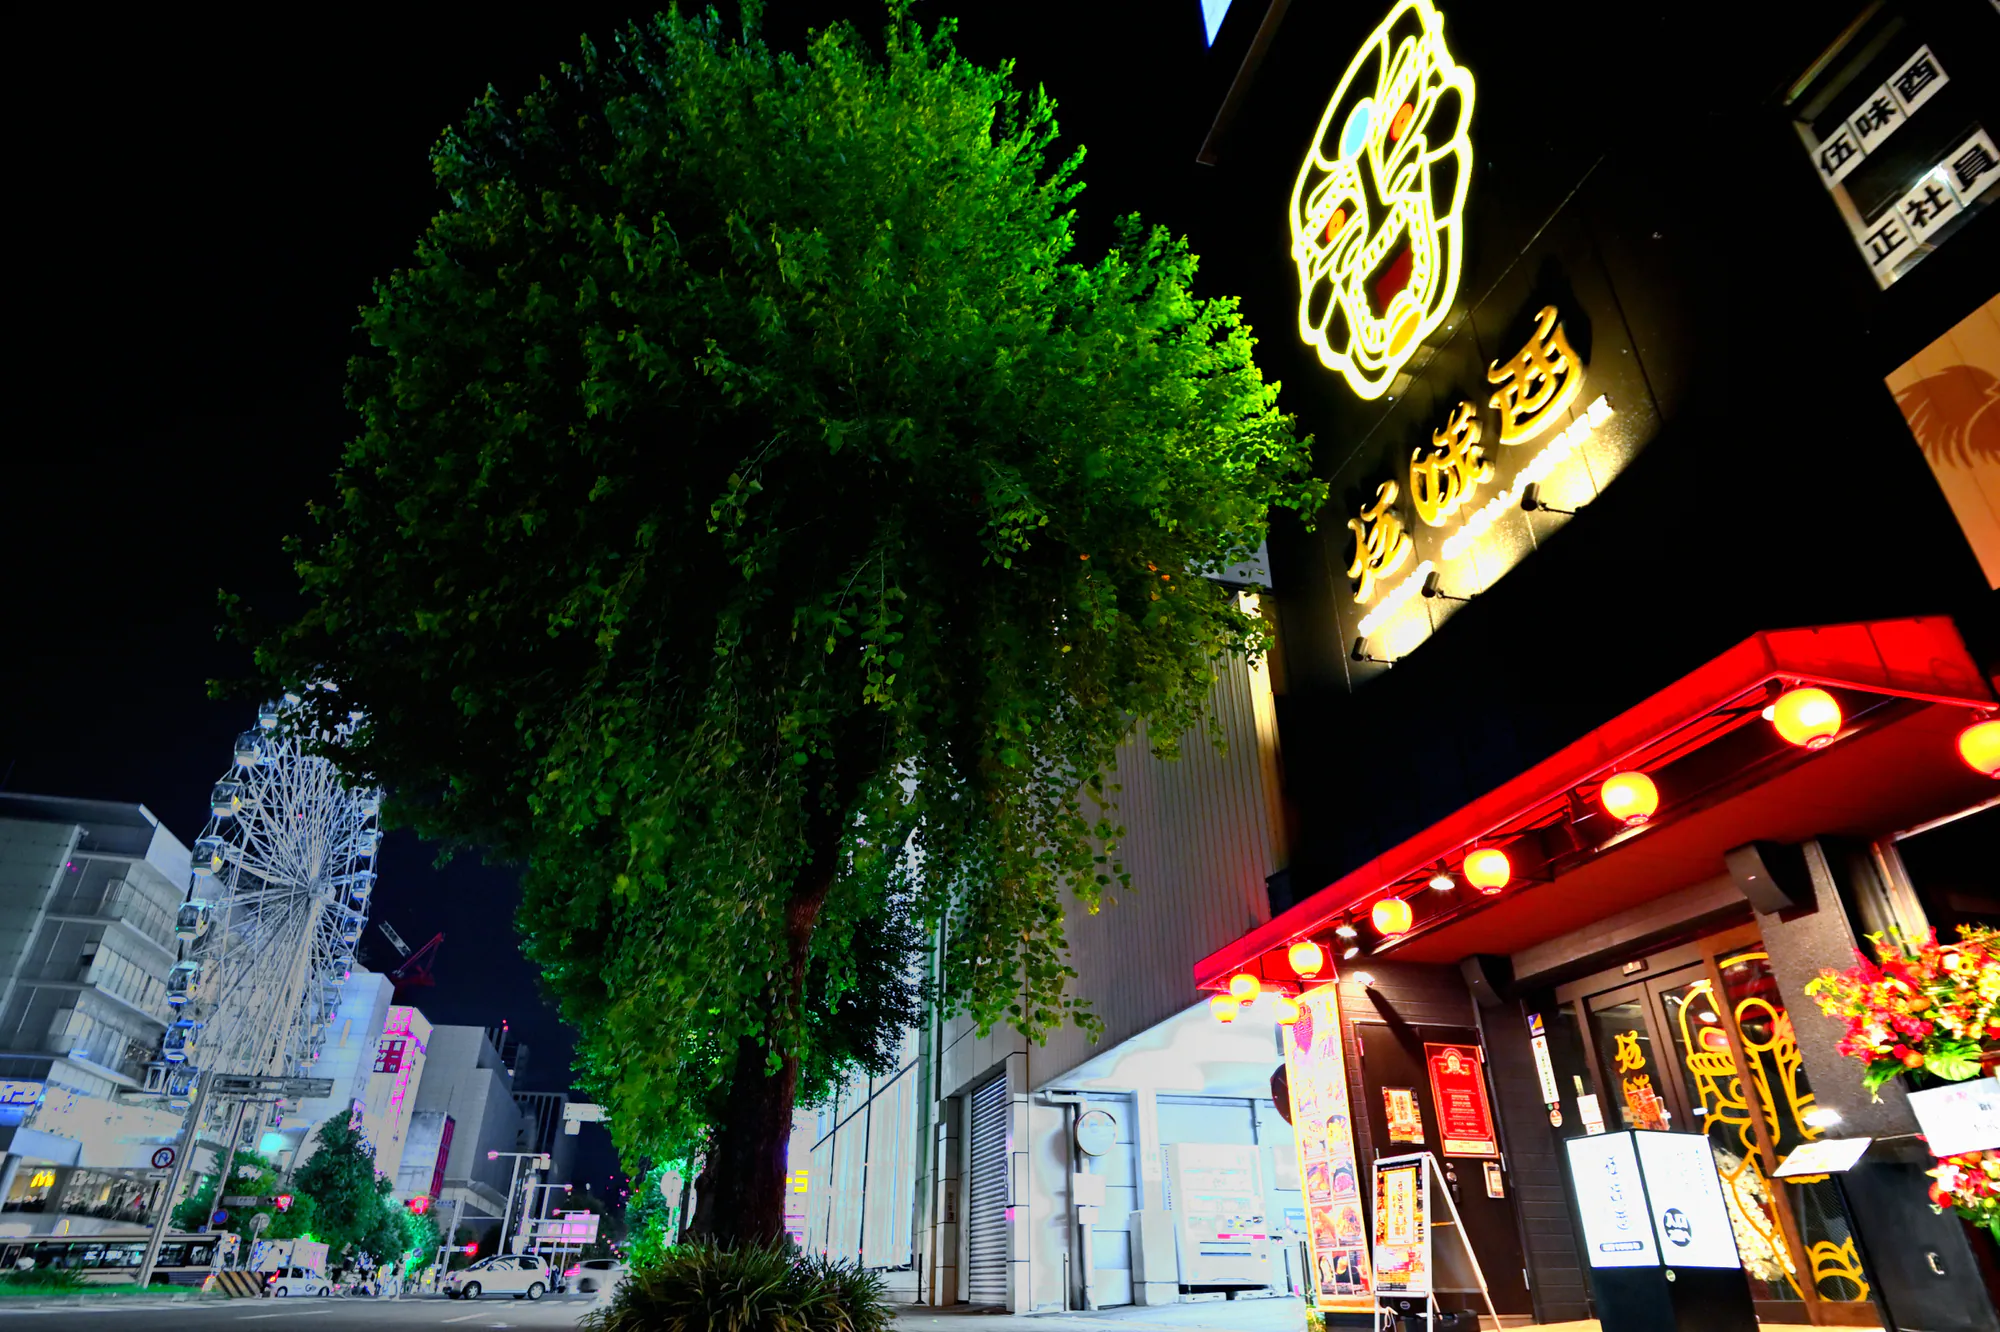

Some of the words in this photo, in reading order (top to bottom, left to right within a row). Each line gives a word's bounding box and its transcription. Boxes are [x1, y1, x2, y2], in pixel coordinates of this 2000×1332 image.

[1819, 51, 1940, 177] 伍味酉
[1864, 142, 1998, 266] 正社員
